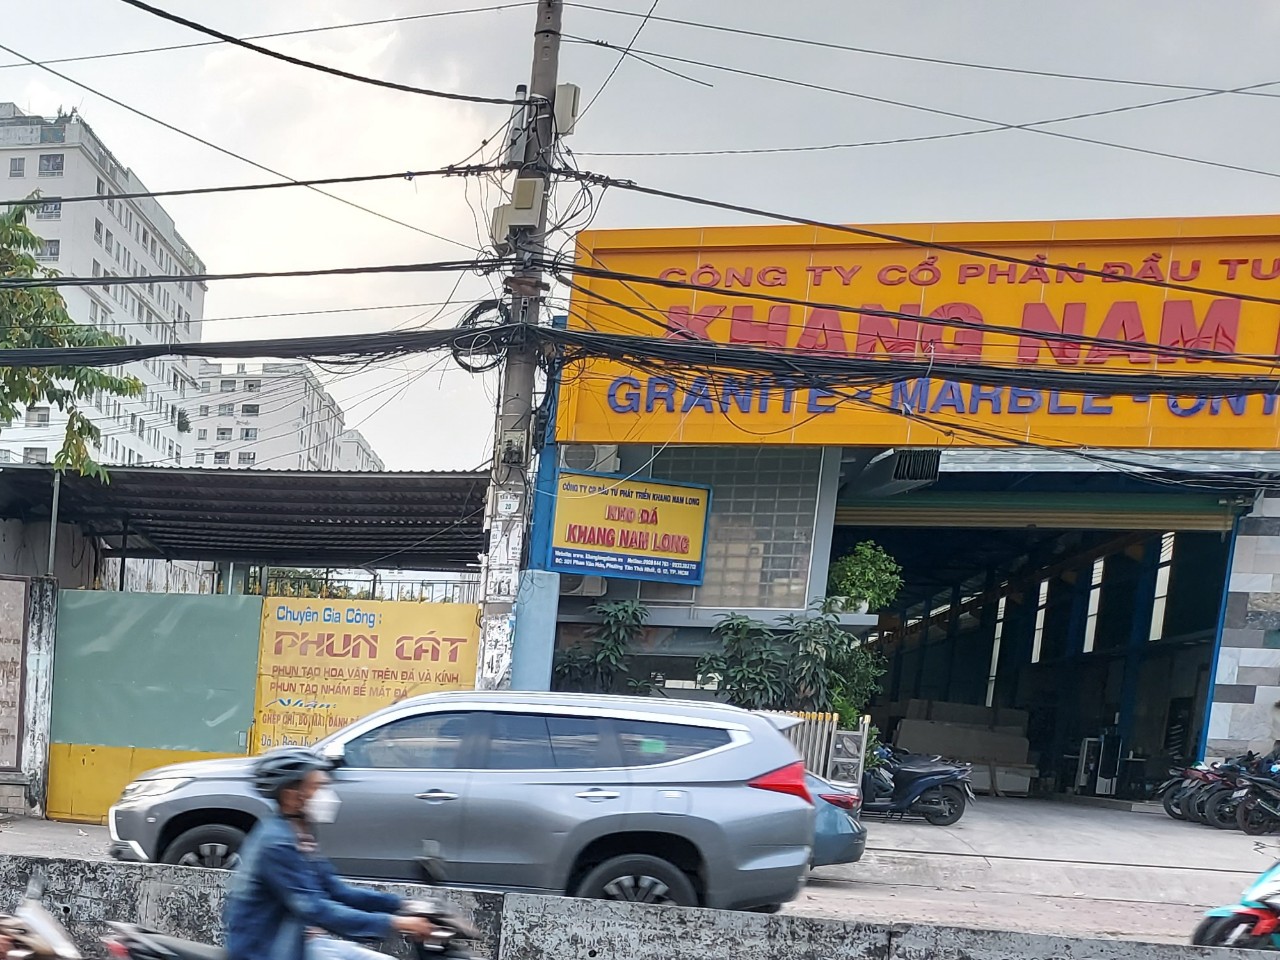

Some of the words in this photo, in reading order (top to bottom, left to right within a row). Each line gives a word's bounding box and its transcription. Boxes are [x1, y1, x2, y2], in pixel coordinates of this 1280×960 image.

[658, 263, 788, 288] CÔNG
[806, 265, 862, 287] TY
[877, 255, 941, 287] CỔ
[664, 301, 984, 365] KHANG
[1017, 299, 1242, 366] NAM
[608, 374, 836, 414] GRANITE
[890, 375, 1113, 415] MARBLE
[565, 523, 616, 548] KHANG
[617, 528, 650, 551] NAM
[651, 532, 690, 554] LONG
[276, 605, 318, 625] Chuyên
[322, 607, 341, 623] Gia
[345, 607, 376, 628] Công
[273, 630, 379, 659] PHUN
[395, 630, 468, 663] CÁT
[270, 682, 297, 692] PHUN
[321, 683, 351, 696] NHÁM
[272, 665, 299, 676] PHUN
[323, 667, 344, 678] HOA
[372, 667, 398, 680] TRÊN
[400, 667, 415, 681] ĐÁ
[417, 668, 432, 682] VÀ
[434, 668, 459, 683] KÍNH
